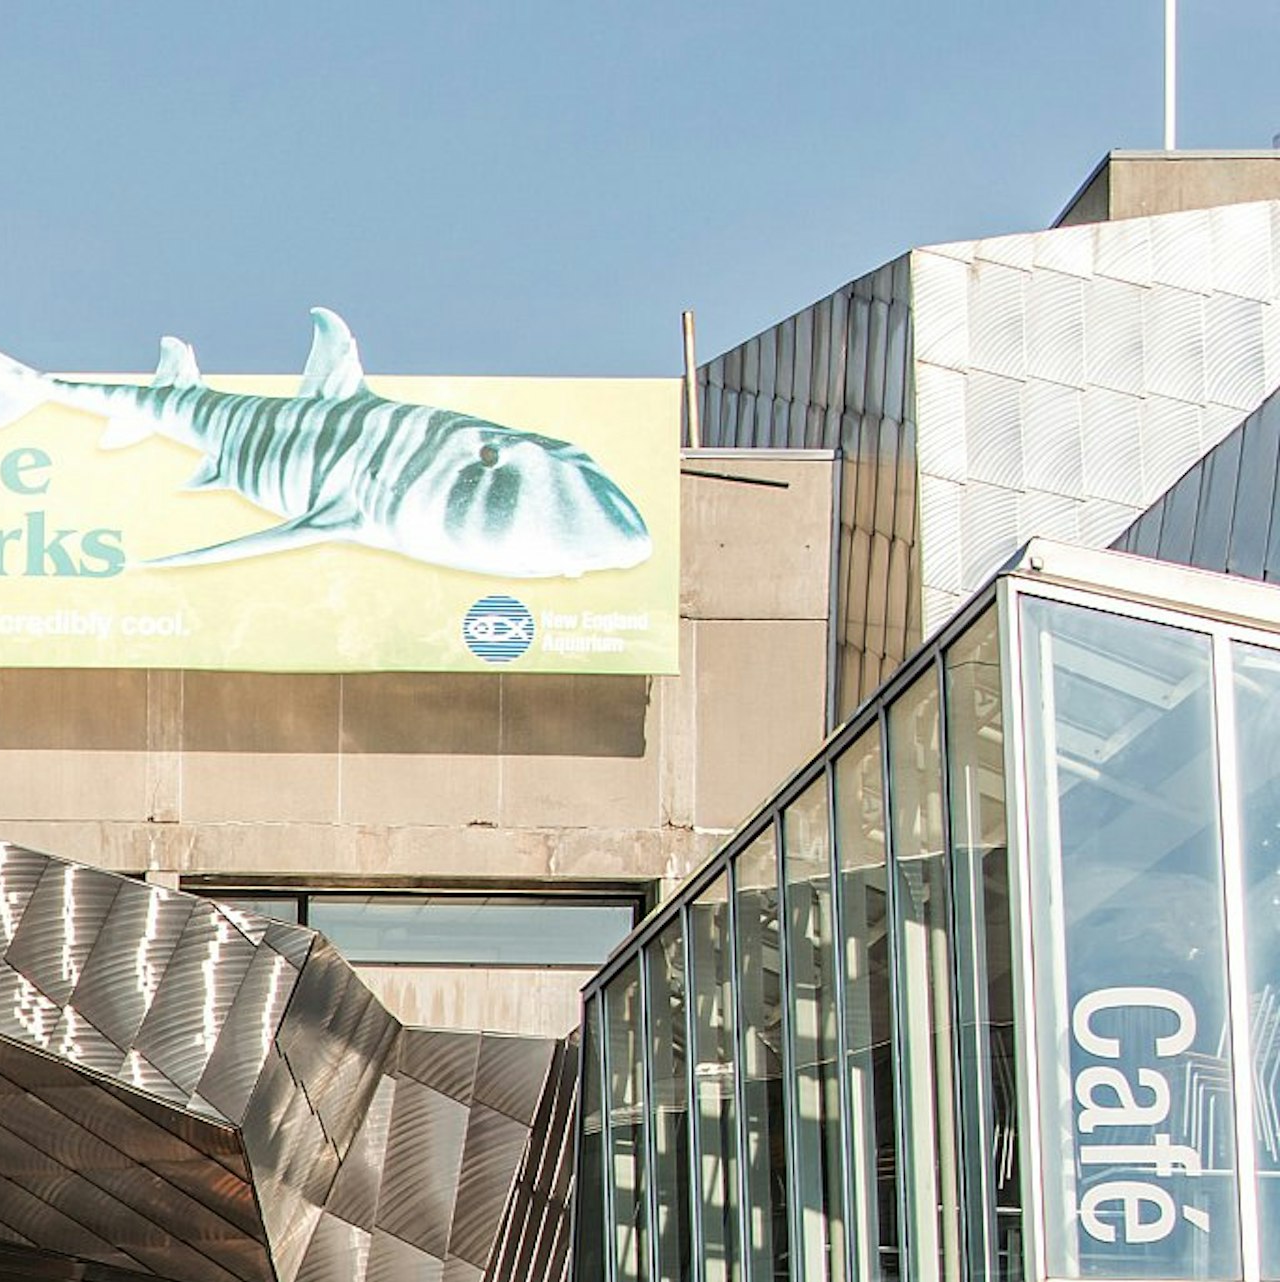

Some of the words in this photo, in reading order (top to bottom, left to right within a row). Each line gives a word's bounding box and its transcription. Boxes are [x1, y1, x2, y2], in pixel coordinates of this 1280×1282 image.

[122, 611, 192, 637] cool.
[543, 611, 578, 630] New
[584, 611, 650, 633] England
[543, 635, 625, 654] Aquarium
[1072, 986, 1210, 1244] Café
